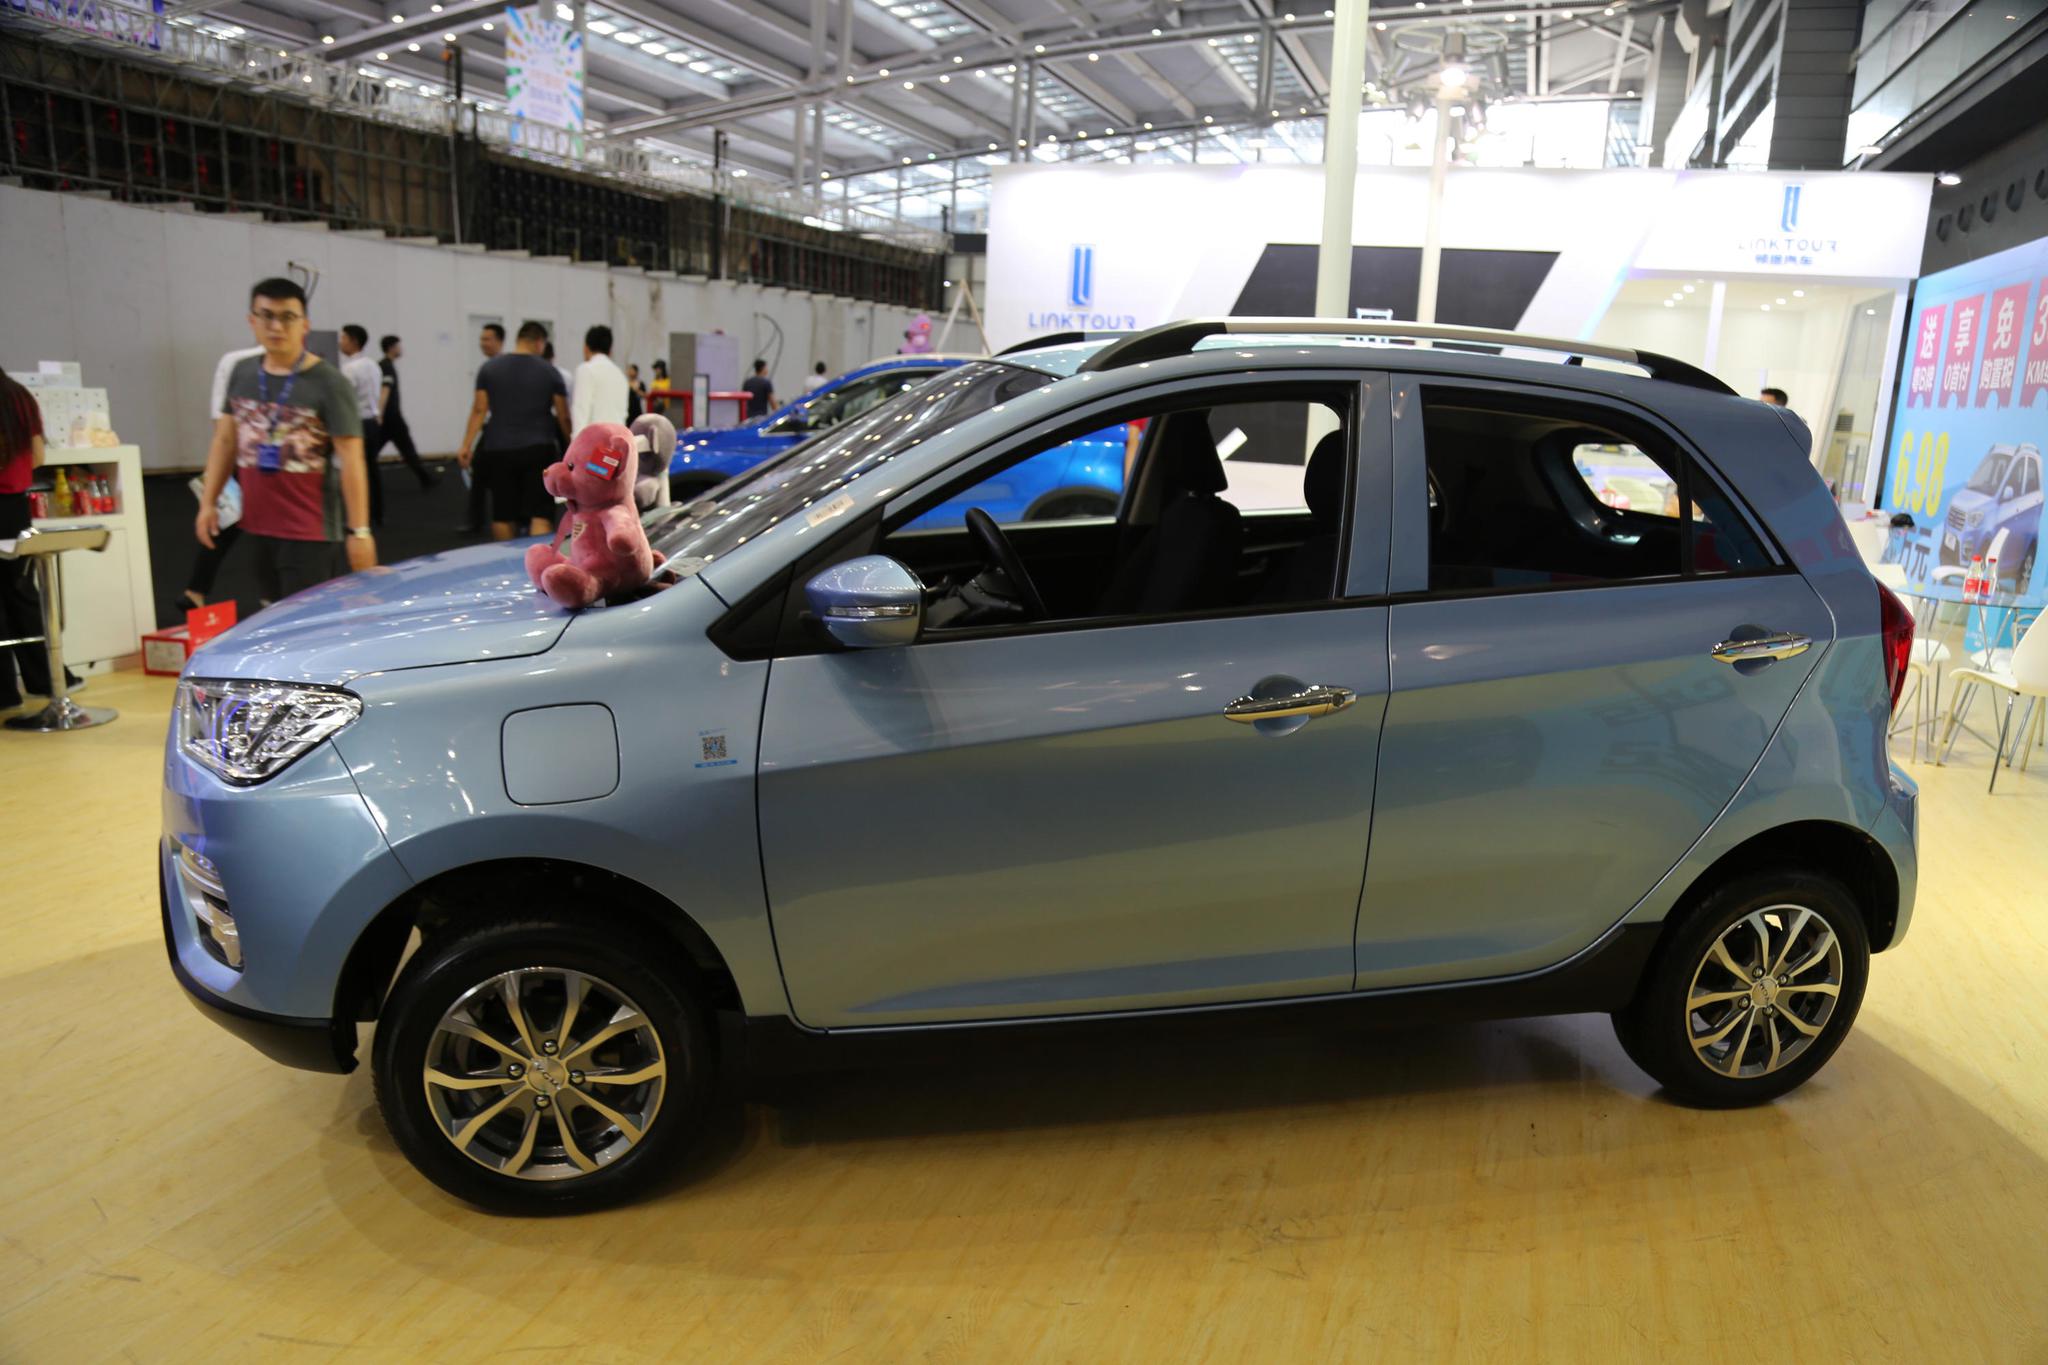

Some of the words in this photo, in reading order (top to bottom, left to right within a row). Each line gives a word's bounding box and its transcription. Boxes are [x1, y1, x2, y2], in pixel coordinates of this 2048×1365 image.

[1920, 314, 1939, 359] 送
[1954, 307, 1975, 356] 享
[1993, 297, 2015, 350] 免
[1979, 355, 2016, 389] 购置税
[2025, 360, 2048, 385] KM
[1893, 430, 1949, 518] 6.98
